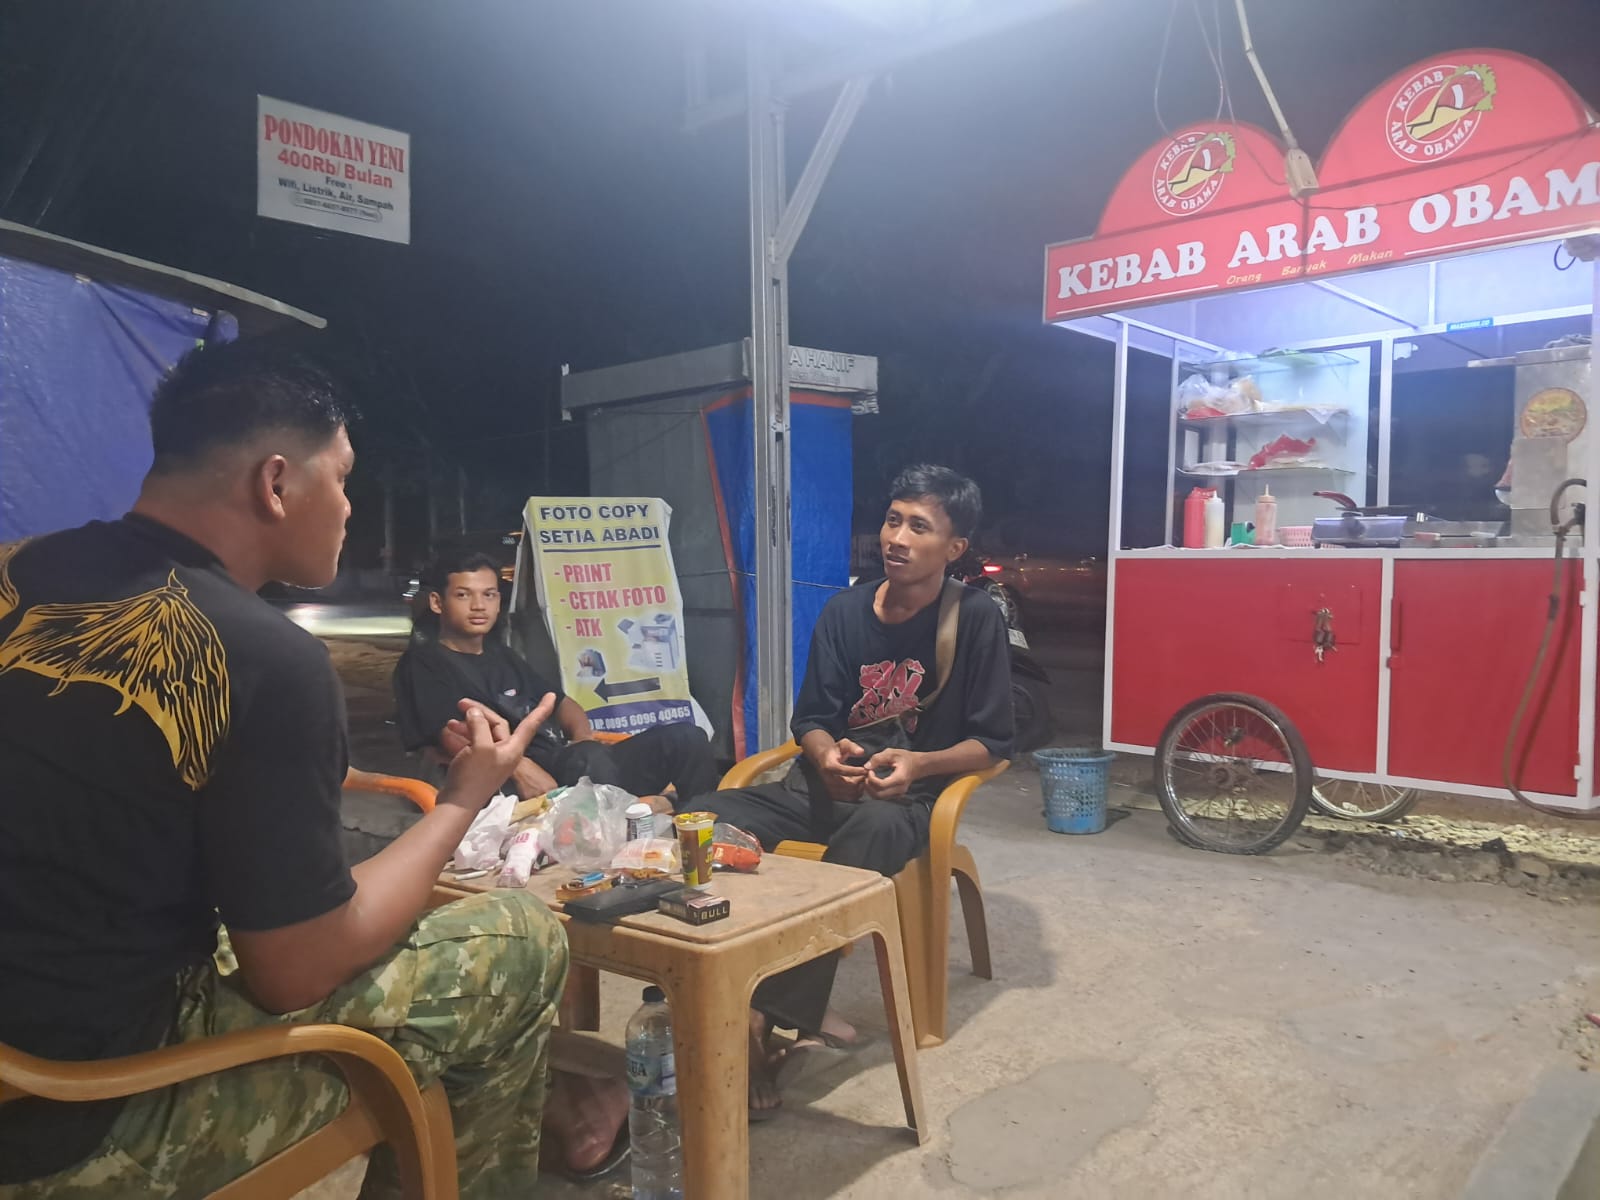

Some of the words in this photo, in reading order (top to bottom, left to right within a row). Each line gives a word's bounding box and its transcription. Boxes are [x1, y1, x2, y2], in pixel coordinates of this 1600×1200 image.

[1395, 71, 1444, 111] KEBAB
[264, 114, 364, 163] PONDOKAN
[368, 140, 405, 173] YENI
[1391, 121, 1418, 154] ARAB
[1423, 119, 1473, 156] OBAMA
[1160, 136, 1196, 171] KEBAB
[344, 164, 393, 188] Bulan
[1156, 179, 1177, 208] ARAB
[1181, 180, 1218, 210] OBAMA
[1057, 241, 1206, 299] KEBAB
[1227, 206, 1381, 268] ARAB
[1226, 272, 1262, 286] Orang
[1347, 248, 1394, 265] Makan
[805, 350, 855, 373] HANIF
[540, 506, 592, 520] FOTO
[598, 504, 649, 519] COPY
[540, 529, 596, 544] SETIA
[602, 526, 660, 543] ABADI
[563, 563, 612, 583] PRINT
[569, 590, 620, 610] CETAK
[622, 585, 667, 606] FOTO
[575, 618, 603, 637] ATK
[630, 712, 657, 727] 6096
[658, 705, 691, 721] 40465
